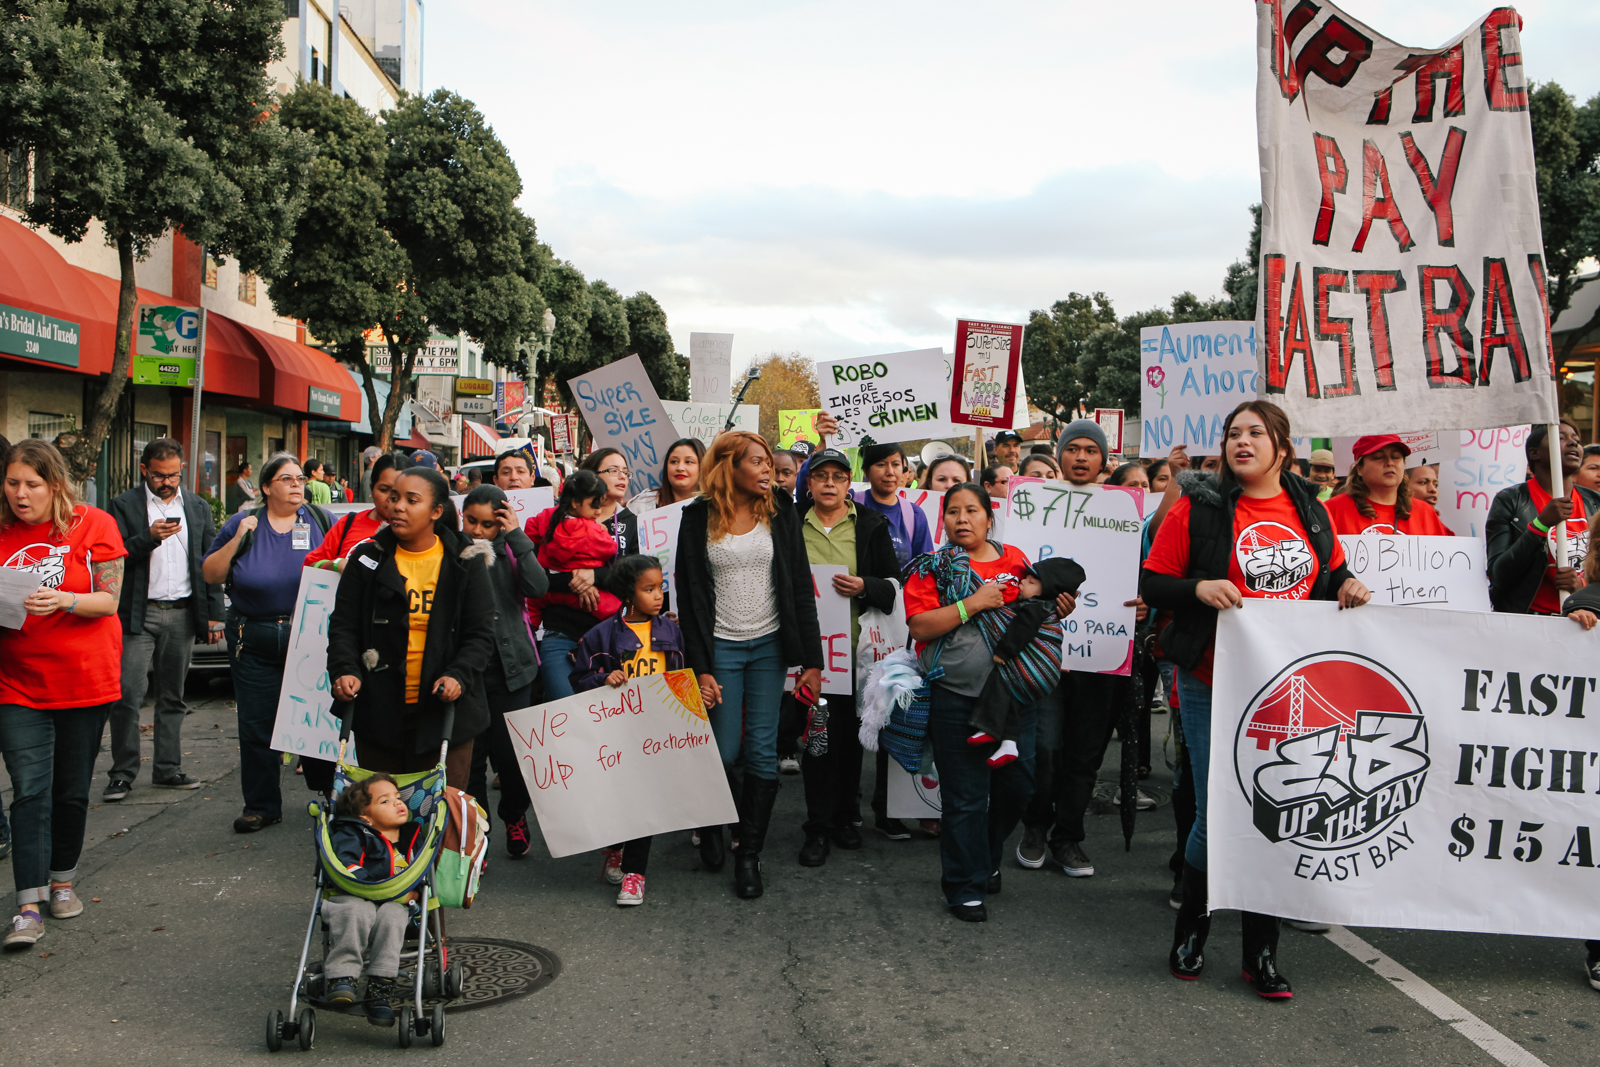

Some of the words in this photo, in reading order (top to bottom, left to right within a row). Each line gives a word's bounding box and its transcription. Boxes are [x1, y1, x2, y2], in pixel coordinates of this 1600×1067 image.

[1313, 126, 1467, 253] PAY
[10, 313, 35, 336] Bridal
[36, 321, 52, 340] And
[53, 324, 78, 346] Tuxedo
[1264, 253, 1407, 399] EAST
[25, 340, 40, 354] 3240
[165, 344, 179, 353] PAY
[182, 345, 198, 354] HER
[439, 347, 458, 356] 7PM
[159, 365, 179, 373] 44223
[439, 358, 458, 367] 6PM
[964, 362, 1000, 382] FAST
[832, 361, 889, 386] ROBO
[460, 383, 490, 392] LUGGAGE
[703, 376, 720, 394] NO
[860, 382, 878, 393] DE
[972, 381, 1002, 396] FOOD
[463, 401, 484, 410] BAGS
[829, 388, 917, 409] INGRESOS
[963, 391, 1000, 409] WAGE
[844, 407, 861, 418] ES
[871, 402, 887, 414] UN
[867, 402, 939, 428] CRIMEN
[782, 415, 805, 437] La
[1144, 414, 1174, 453] NO
[1454, 456, 1517, 487] Size
[1083, 515, 1141, 533] MILLONES
[1378, 536, 1472, 573] Billion
[1254, 573, 1272, 590] UP
[1272, 573, 1291, 591] THE
[1293, 561, 1313, 581] PAY
[1290, 580, 1310, 601] BAY
[1386, 577, 1448, 603] them
[869, 625, 885, 645] hi,
[1083, 620, 1129, 637] PARA
[1461, 669, 1597, 719] FAST
[507, 709, 568, 750] We
[282, 733, 306, 750] no
[523, 754, 574, 790] Up
[597, 744, 622, 772] for
[642, 732, 710, 755] eachother
[1278, 801, 1319, 830] UP
[1324, 799, 1368, 845] THE
[1375, 774, 1421, 822] PAY
[1293, 852, 1361, 882] EAST
[1367, 820, 1415, 870] BAY
[1447, 812, 1545, 863] $15
[1557, 825, 1600, 869] A
